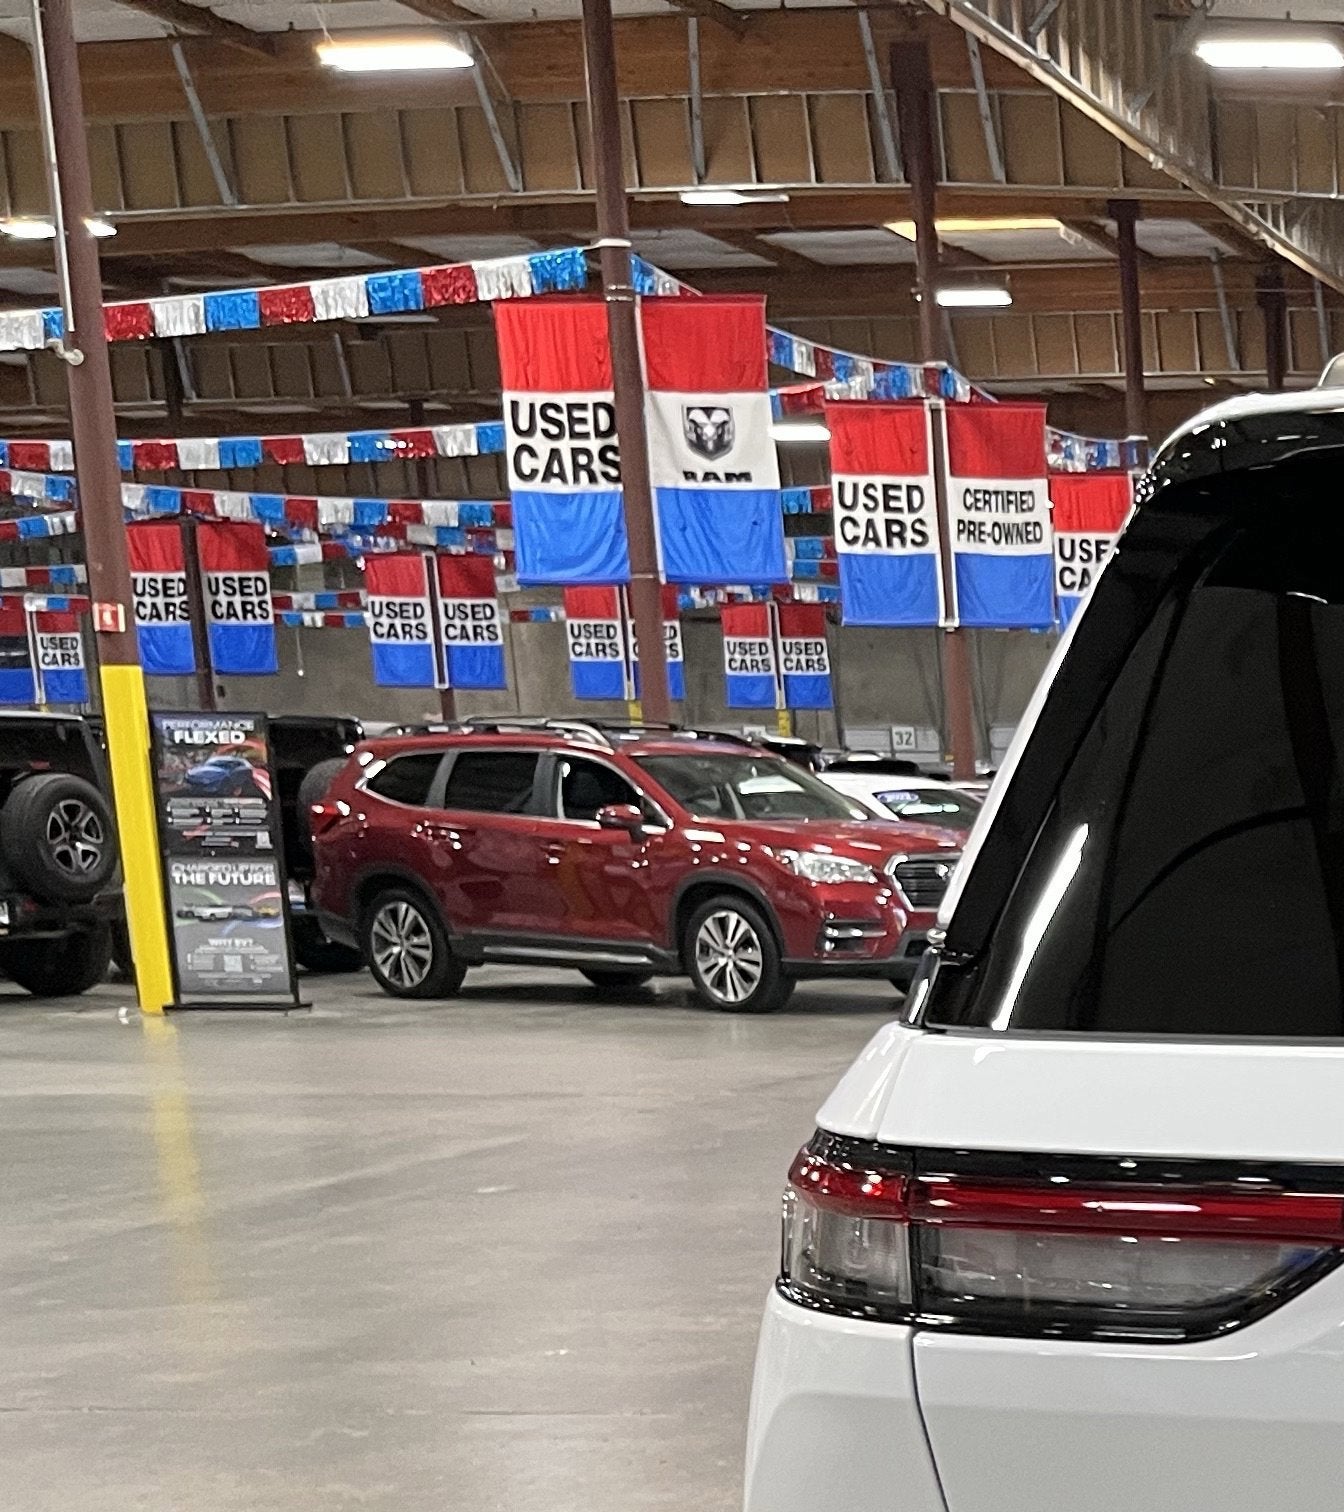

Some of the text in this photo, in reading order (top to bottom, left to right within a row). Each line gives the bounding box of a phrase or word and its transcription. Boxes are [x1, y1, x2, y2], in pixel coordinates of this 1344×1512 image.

[510, 400, 617, 442] USED
[512, 444, 621, 485] CARS
[682, 470, 753, 483] RAM
[838, 481, 925, 514] USED
[963, 488, 1036, 513] CERTIFIED
[840, 516, 929, 549] CARS
[956, 519, 1044, 545] PRE-OWNED
[1058, 538, 1111, 563] USE
[132, 578, 187, 598] USED
[207, 576, 268, 597] USED
[1058, 566, 1092, 592] CA
[135, 600, 190, 621] CARS
[211, 600, 269, 621] CARS
[371, 601, 425, 620] USED
[443, 602, 495, 621] USED
[373, 621, 428, 641] CARS
[444, 623, 499, 641] CARS
[570, 623, 618, 640] USED
[41, 637, 79, 650] USED
[571, 642, 620, 658] CARS
[727, 641, 769, 656] USED
[782, 641, 825, 656] USED
[41, 653, 80, 666] CARS
[728, 658, 772, 672] CARS
[783, 658, 827, 672] CARS
[174, 730, 246, 744] FLEXED
[172, 872, 276, 886] THE FUTURE
